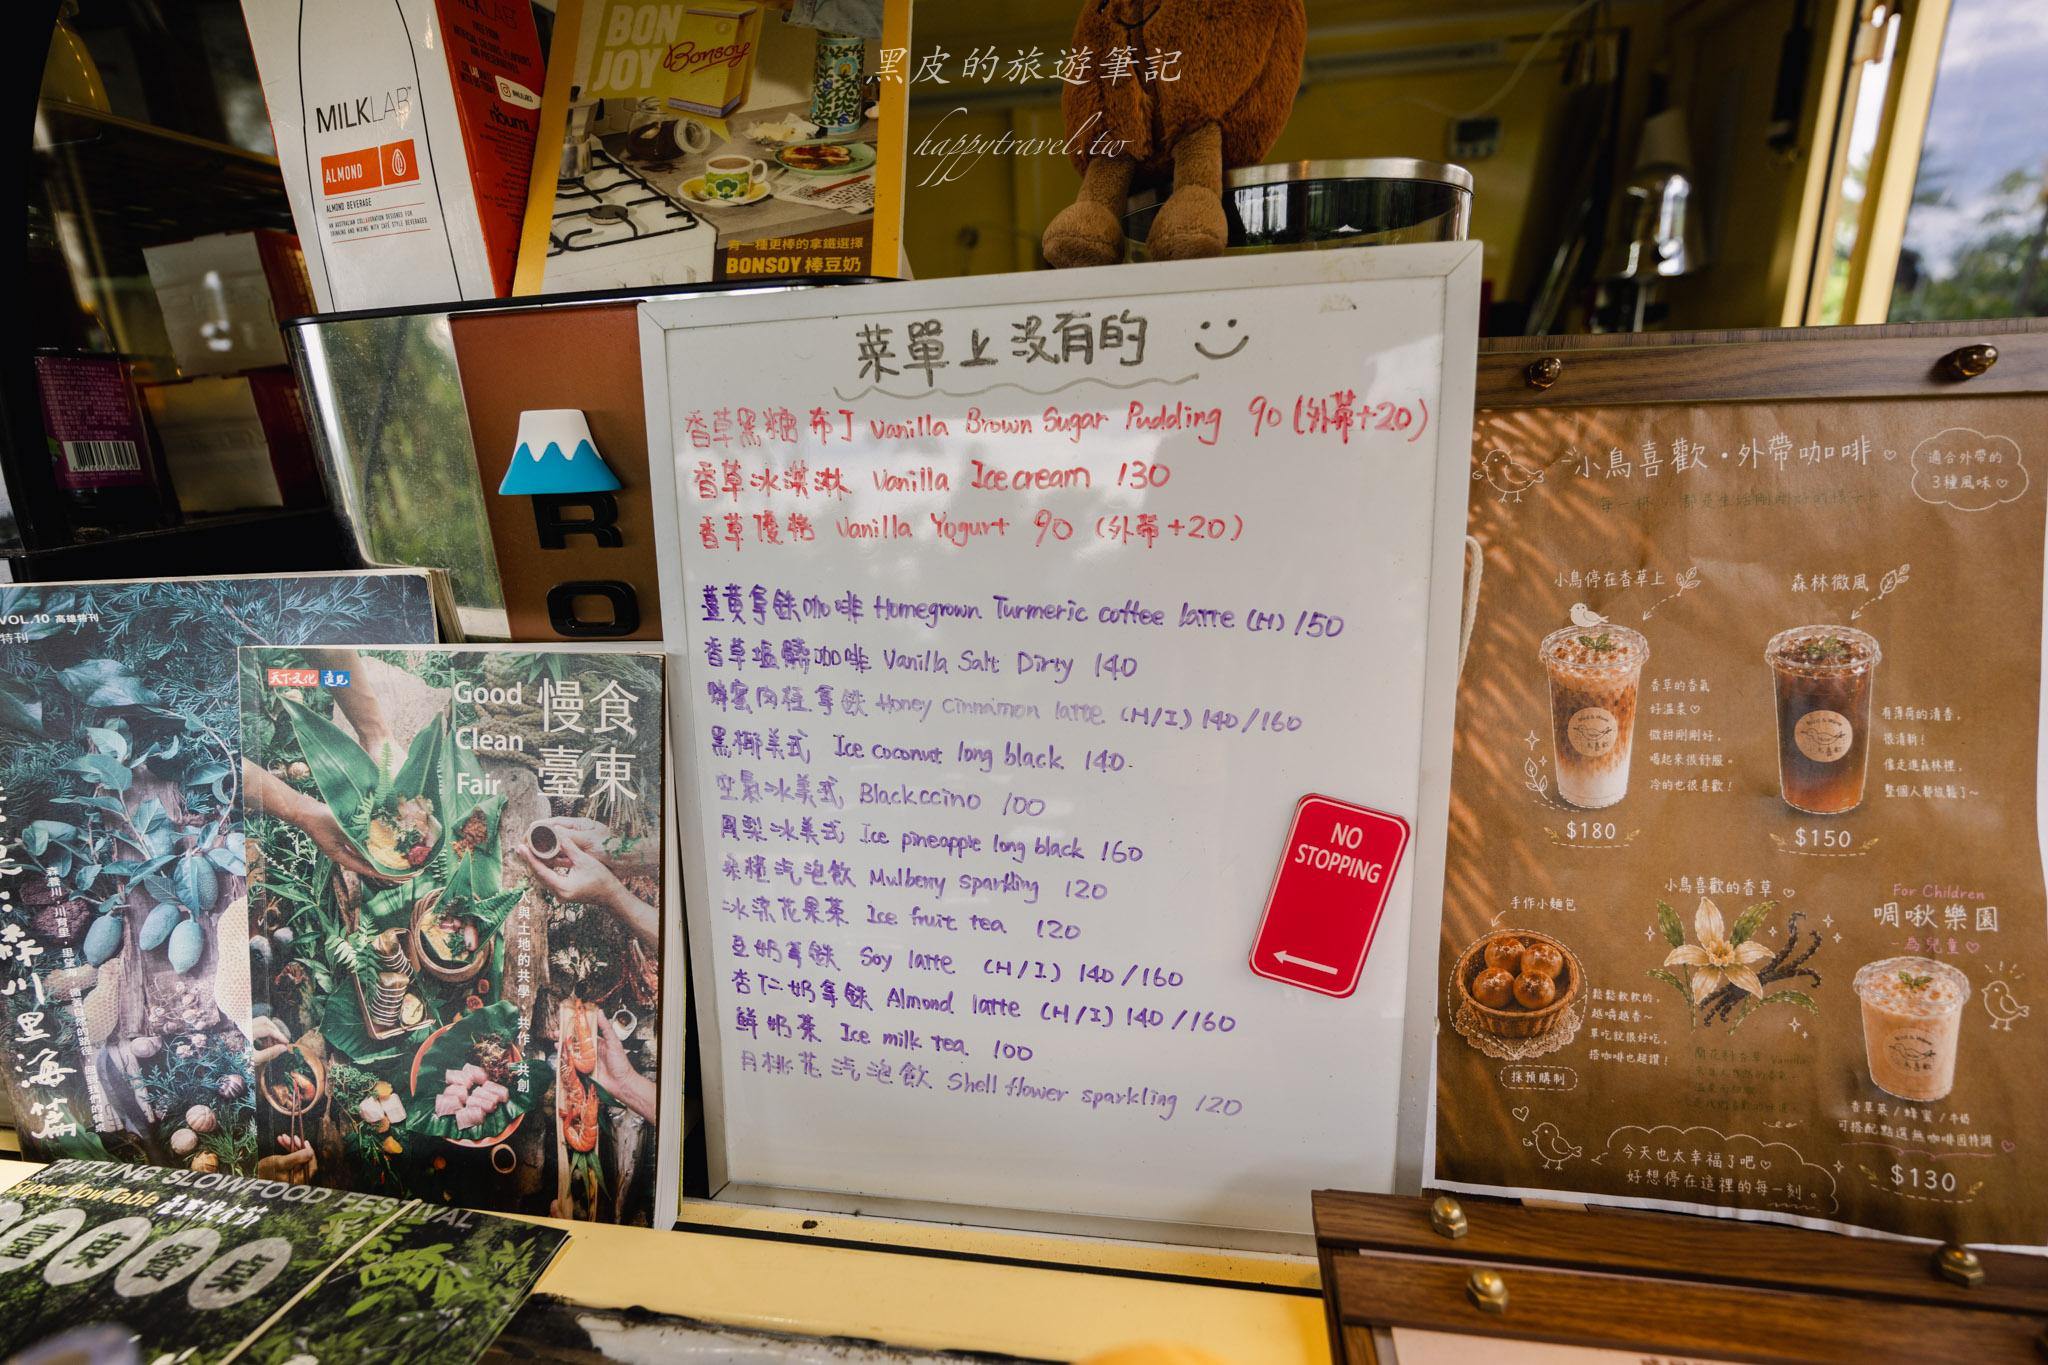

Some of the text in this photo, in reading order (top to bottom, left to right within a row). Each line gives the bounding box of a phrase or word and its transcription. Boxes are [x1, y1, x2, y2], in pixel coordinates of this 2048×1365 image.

[605, 4, 683, 46] BON
[592, 48, 664, 92] JOY
[663, 41, 752, 75] Bonsoy
[325, 163, 363, 184] ALMOND
[326, 197, 372, 213] ALMOND BEVERAGE
[335, 218, 356, 228] AUSTRALIAN
[385, 211, 403, 221] DESIGNED
[370, 223, 379, 231] WITH
[404, 216, 428, 227] BEVERAGES
[726, 255, 862, 274] BONSOY 棒豆奶
[855, 308, 1148, 388] 菜單上沒有的
[869, 413, 949, 438] Vanilla
[965, 406, 1033, 435] Brown
[1041, 404, 1108, 444] Sugar
[1125, 400, 1222, 445] Pudding
[1248, 395, 1283, 438] 90
[1927, 448, 2003, 466] 適合外帶的
[693, 458, 1171, 502] 香草冰淇淋 Vanilla 130
[1931, 474, 1992, 491] 3種風味
[835, 513, 914, 540] Vanilla
[929, 511, 1011, 548] Yogurt
[1034, 508, 1074, 548] 90
[1553, 567, 1666, 589] 小鳥停在香草上
[1790, 572, 1870, 593] 森林微風
[55, 613, 100, 625] 高雄特刊
[873, 595, 984, 629] Homegrown
[992, 594, 1089, 624] Turmeric
[1098, 599, 1166, 626] coffee
[1178, 601, 1236, 628] latte
[1246, 608, 1286, 632] (H)
[324, 670, 349, 687] 遠見
[883, 649, 949, 674] Vanilla
[957, 649, 1002, 674] Salt
[1016, 650, 1074, 684] Dirty
[1094, 651, 1138, 681] 140
[453, 681, 523, 705] Good
[1650, 678, 1711, 694] 香草的香氣
[537, 677, 640, 736] 慢食
[875, 692, 933, 724] Honey
[1054, 700, 1106, 726] latte
[455, 727, 524, 751] Clean
[832, 734, 866, 759] Ice
[957, 740, 993, 773] long
[1004, 739, 1065, 772] black
[456, 772, 501, 796] Fair
[537, 744, 639, 802] 臺東
[1002, 792, 1047, 817] 100
[860, 822, 890, 846] Ice
[901, 829, 982, 859] pineapple
[992, 833, 1027, 864] long
[1034, 835, 1085, 860] black
[1100, 840, 1144, 864] 160
[1330, 822, 1364, 850] NO
[1566, 819, 1618, 841] $180
[1794, 826, 1852, 849] $150
[1294, 843, 1383, 884] STOPPING
[869, 867, 946, 899] Mulberry
[959, 870, 1040, 904] sparkling
[1065, 878, 1109, 901] 120
[1664, 875, 1774, 898] 小鳥喜歡的香草
[1892, 882, 1986, 901] For Children
[1509, 895, 1577, 912] 手作小麵包
[1873, 900, 1999, 933] 啁啾樂園
[866, 903, 899, 925] Ice
[908, 905, 958, 932] fruit
[969, 913, 1008, 935] tea
[1036, 919, 1082, 940] 120
[1904, 935, 1960, 955] 為兒童
[860, 945, 893, 973] Soy
[908, 949, 956, 975] latte
[886, 987, 955, 1015] Almond
[972, 993, 1022, 1018] latte
[839, 1021, 872, 1046] Ice
[882, 1028, 923, 1050] milk
[931, 1034, 969, 1056] tea
[994, 1039, 1034, 1062] 100
[1510, 1070, 1566, 1086] 採預購制
[946, 1072, 998, 1095] Shell
[1004, 1075, 1070, 1103] flower
[1080, 1085, 1179, 1122] sparkling
[1194, 1094, 1244, 1117] 120
[1621, 1142, 1757, 1170] 今天也太幸福了吧
[50, 1158, 164, 1182] TAITUNG
[161, 1167, 332, 1205] SLOWFOOD
[1890, 1163, 1958, 1194] $130
[105, 1187, 160, 1208] Table
